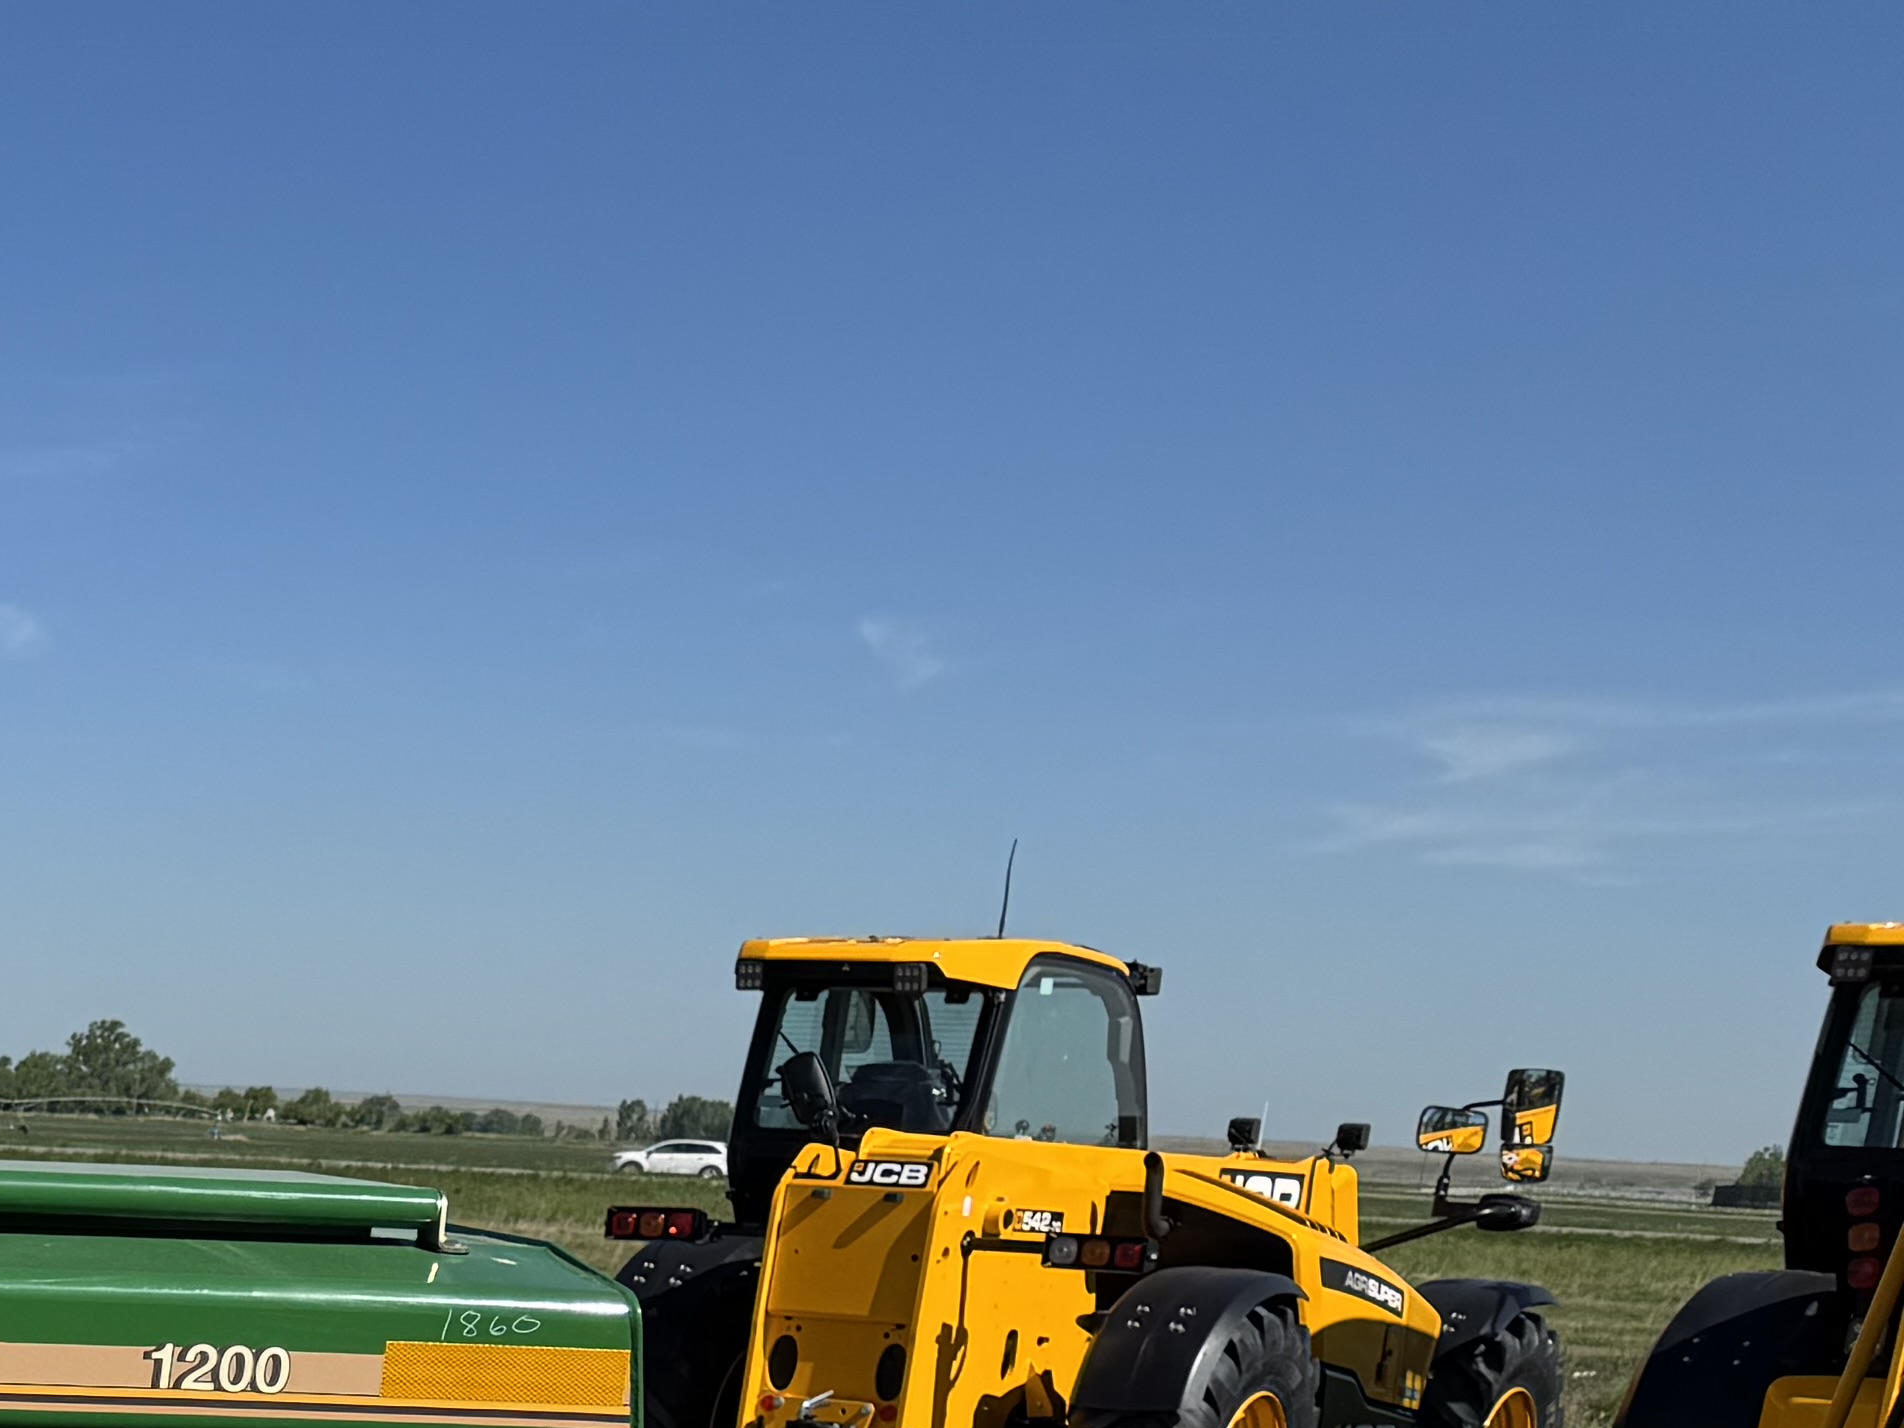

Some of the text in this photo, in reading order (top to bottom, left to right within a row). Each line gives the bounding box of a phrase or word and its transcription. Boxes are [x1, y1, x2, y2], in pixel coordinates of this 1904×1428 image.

[850, 1162, 928, 1185] JCB
[441, 1308, 542, 1341] 1860
[145, 1341, 291, 1394] 1200
